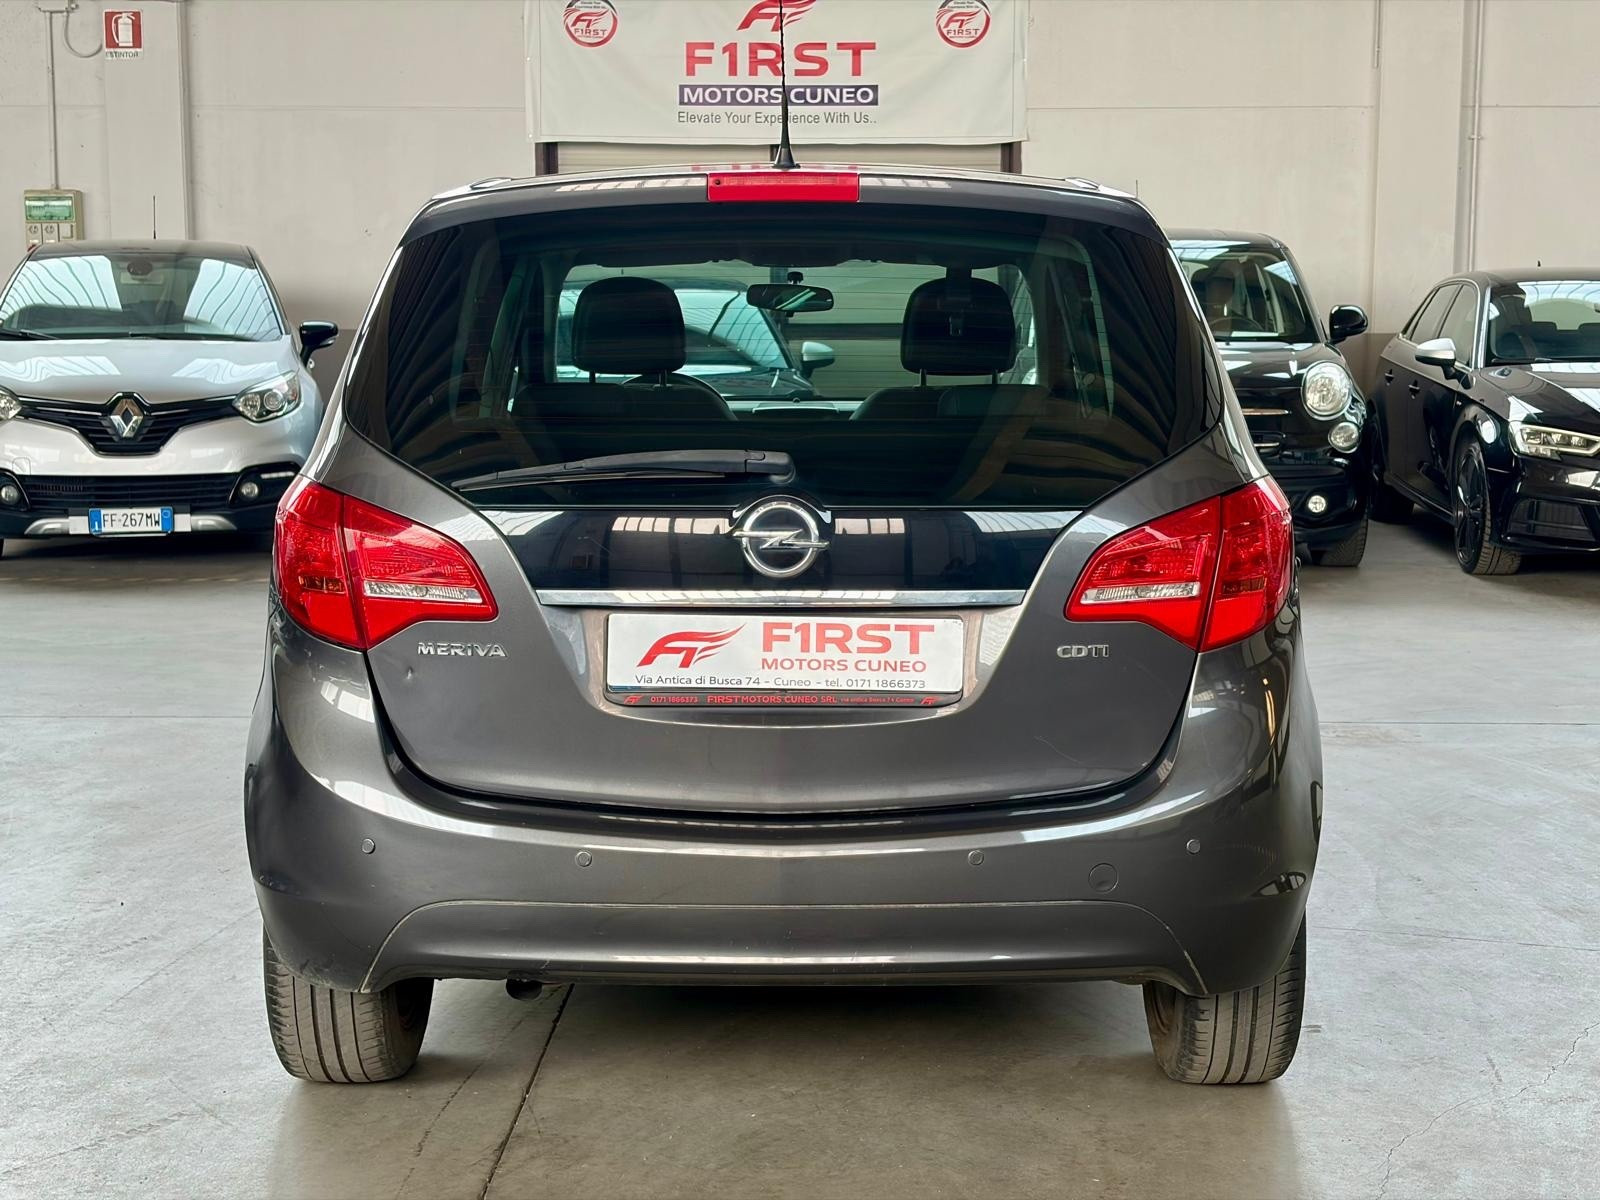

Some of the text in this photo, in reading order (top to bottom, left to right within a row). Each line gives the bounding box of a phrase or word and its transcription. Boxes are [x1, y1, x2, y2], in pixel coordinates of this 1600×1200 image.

[685, 42, 876, 77] F1RST
[683, 87, 874, 104] MOTORS CUNEO
[677, 111, 721, 124] Elevate
[725, 111, 751, 124] Your
[755, 111, 820, 126] Expeience
[823, 111, 850, 124] With
[762, 621, 935, 655] F1RST
[417, 642, 506, 657] MERIVA
[1056, 644, 1110, 658] CDTI
[761, 658, 927, 673] MOTORS CUNEO
[635, 675, 653, 685] Via
[655, 675, 692, 685] Antica
[695, 675, 706, 685] di
[709, 676, 742, 686] Busca
[745, 676, 760, 686] 74
[773, 677, 811, 687] Cuneo
[825, 678, 842, 688] tel.
[846, 678, 871, 688] 0171
[876, 679, 926, 689] 1866373
[741, 695, 782, 704] MOTORS
[784, 695, 818, 704] CUNEO
[820, 695, 838, 704] SRL
